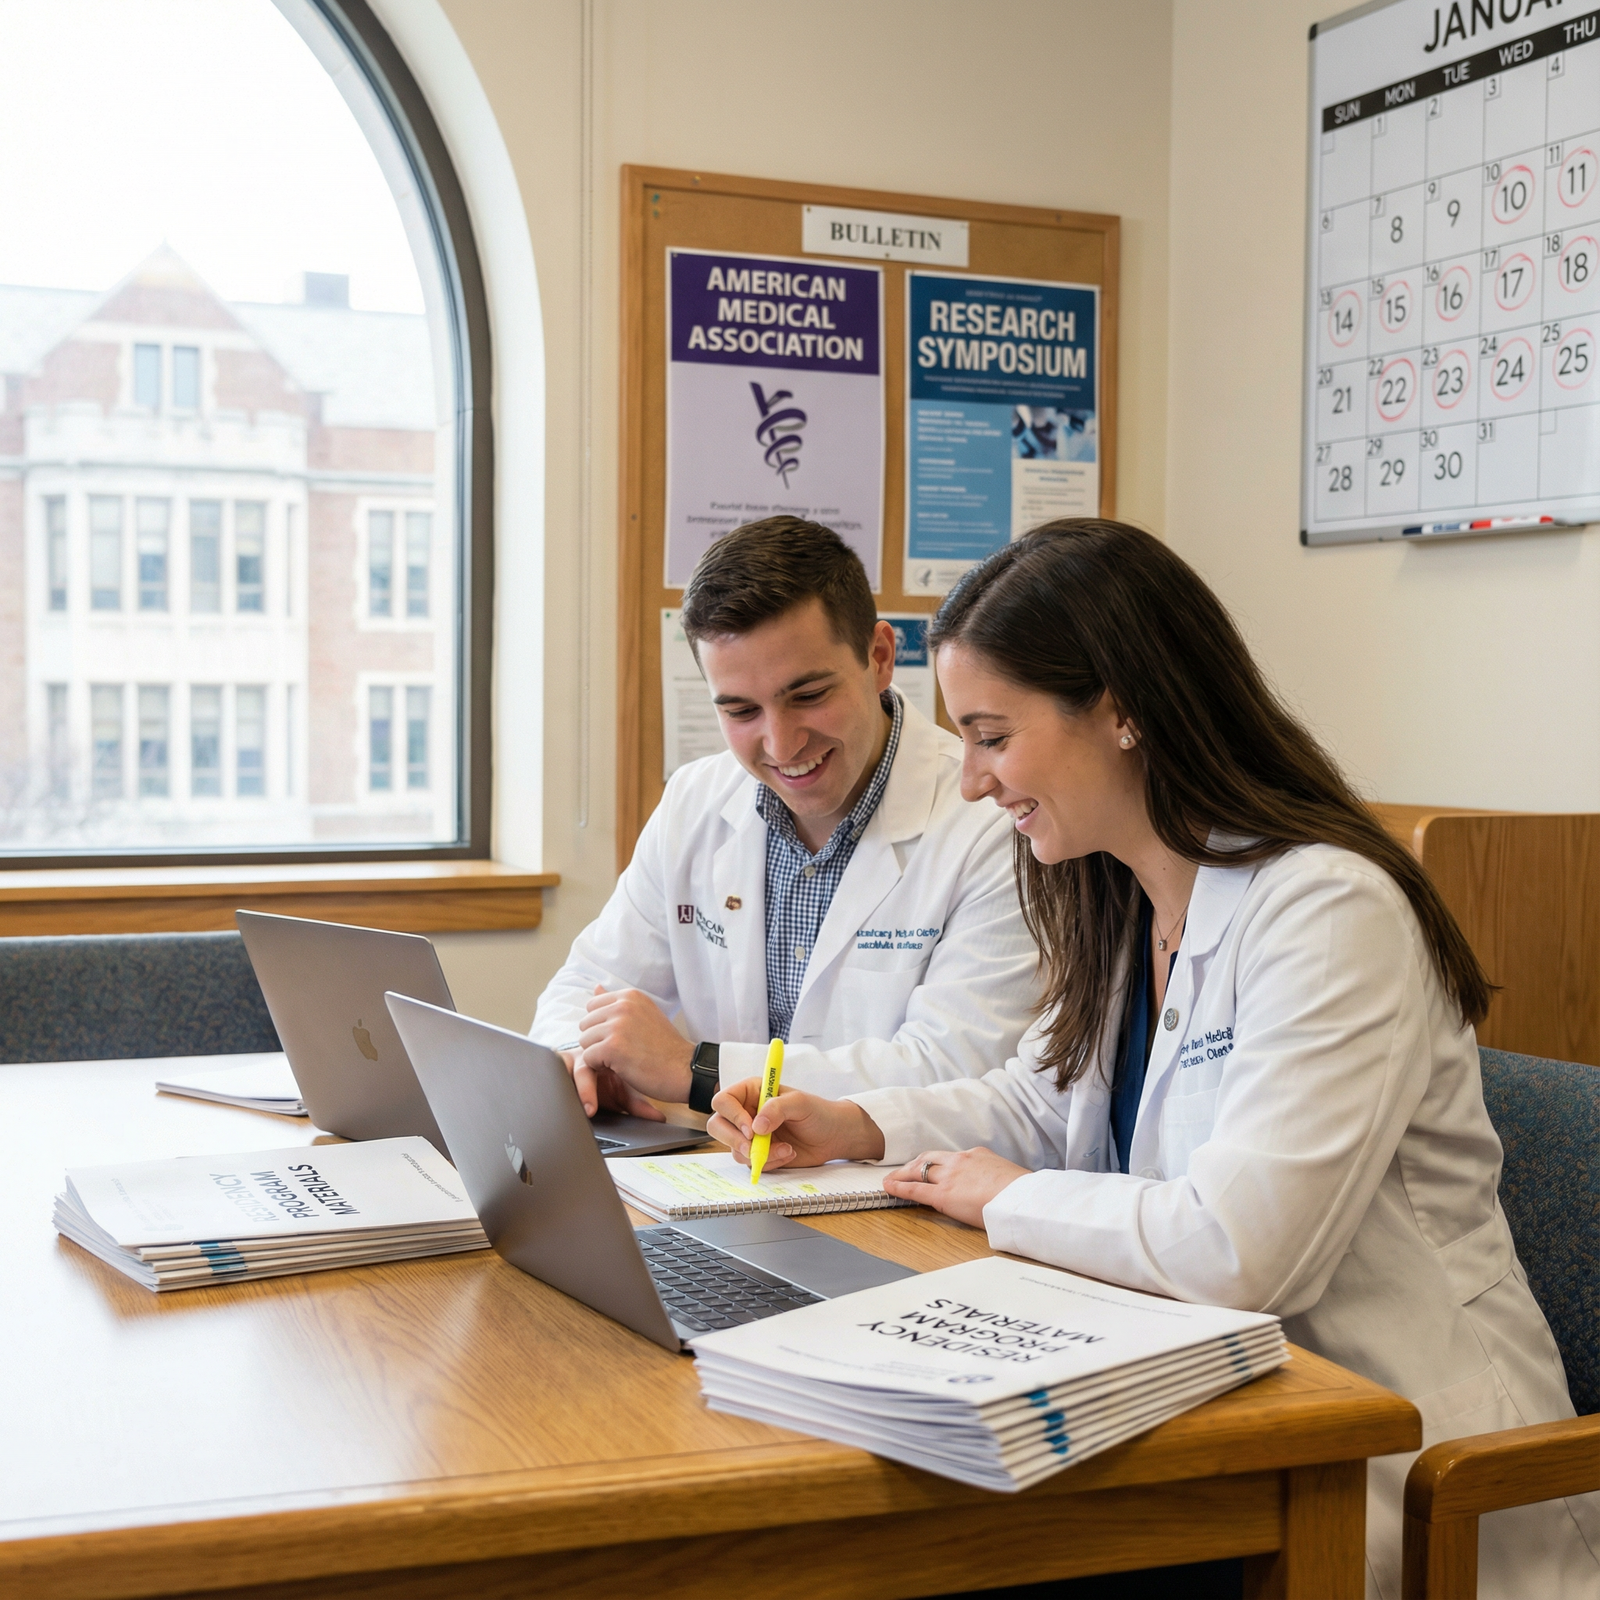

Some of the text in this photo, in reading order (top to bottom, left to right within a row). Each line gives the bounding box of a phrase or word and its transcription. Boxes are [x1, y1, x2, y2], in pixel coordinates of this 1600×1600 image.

[1424, 0, 1564, 53] JANU
[1334, 16, 1597, 124] SUN MON TUE WED THU
[1429, 98, 1438, 116] 2
[1488, 78, 1497, 95] 3
[1551, 56, 1560, 74] 4
[1428, 182, 1436, 197] 9
[1485, 163, 1500, 182] 10
[1549, 145, 1561, 164] 11
[1390, 163, 1586, 243] 8 9 10 11
[831, 222, 942, 250] BULLETIN
[707, 266, 847, 302] AMERICAN
[1372, 279, 1384, 296] 15
[1426, 265, 1439, 283] 16
[1485, 250, 1497, 269] 17
[1546, 234, 1560, 253] 18
[718, 298, 836, 330] MEDICAL
[1334, 252, 1588, 335] 14 15 16 17 18
[688, 325, 864, 362] ASSOCIATION
[930, 300, 1076, 342] RESEARCH
[918, 336, 1087, 379] SYMPOSIUM
[1369, 358, 1384, 376] 22
[1423, 348, 1439, 366] 23
[1480, 336, 1497, 355] 24
[1542, 323, 1560, 343] 25
[1332, 342, 1588, 414] 21 22 23 24 25
[1367, 438, 1382, 456] 29
[1421, 430, 1437, 448] 30
[1479, 421, 1493, 440] 31
[1328, 451, 1463, 492] 28 29 30
[208, 1173, 281, 1224] RESIDENCY
[250, 1170, 320, 1219] PROGRAM
[287, 1163, 361, 1216] MATERIALS
[857, 1320, 1042, 1364] RESIDENCY
[899, 1312, 1069, 1354] PROGRAM
[924, 1298, 1106, 1344] MATERIALS
